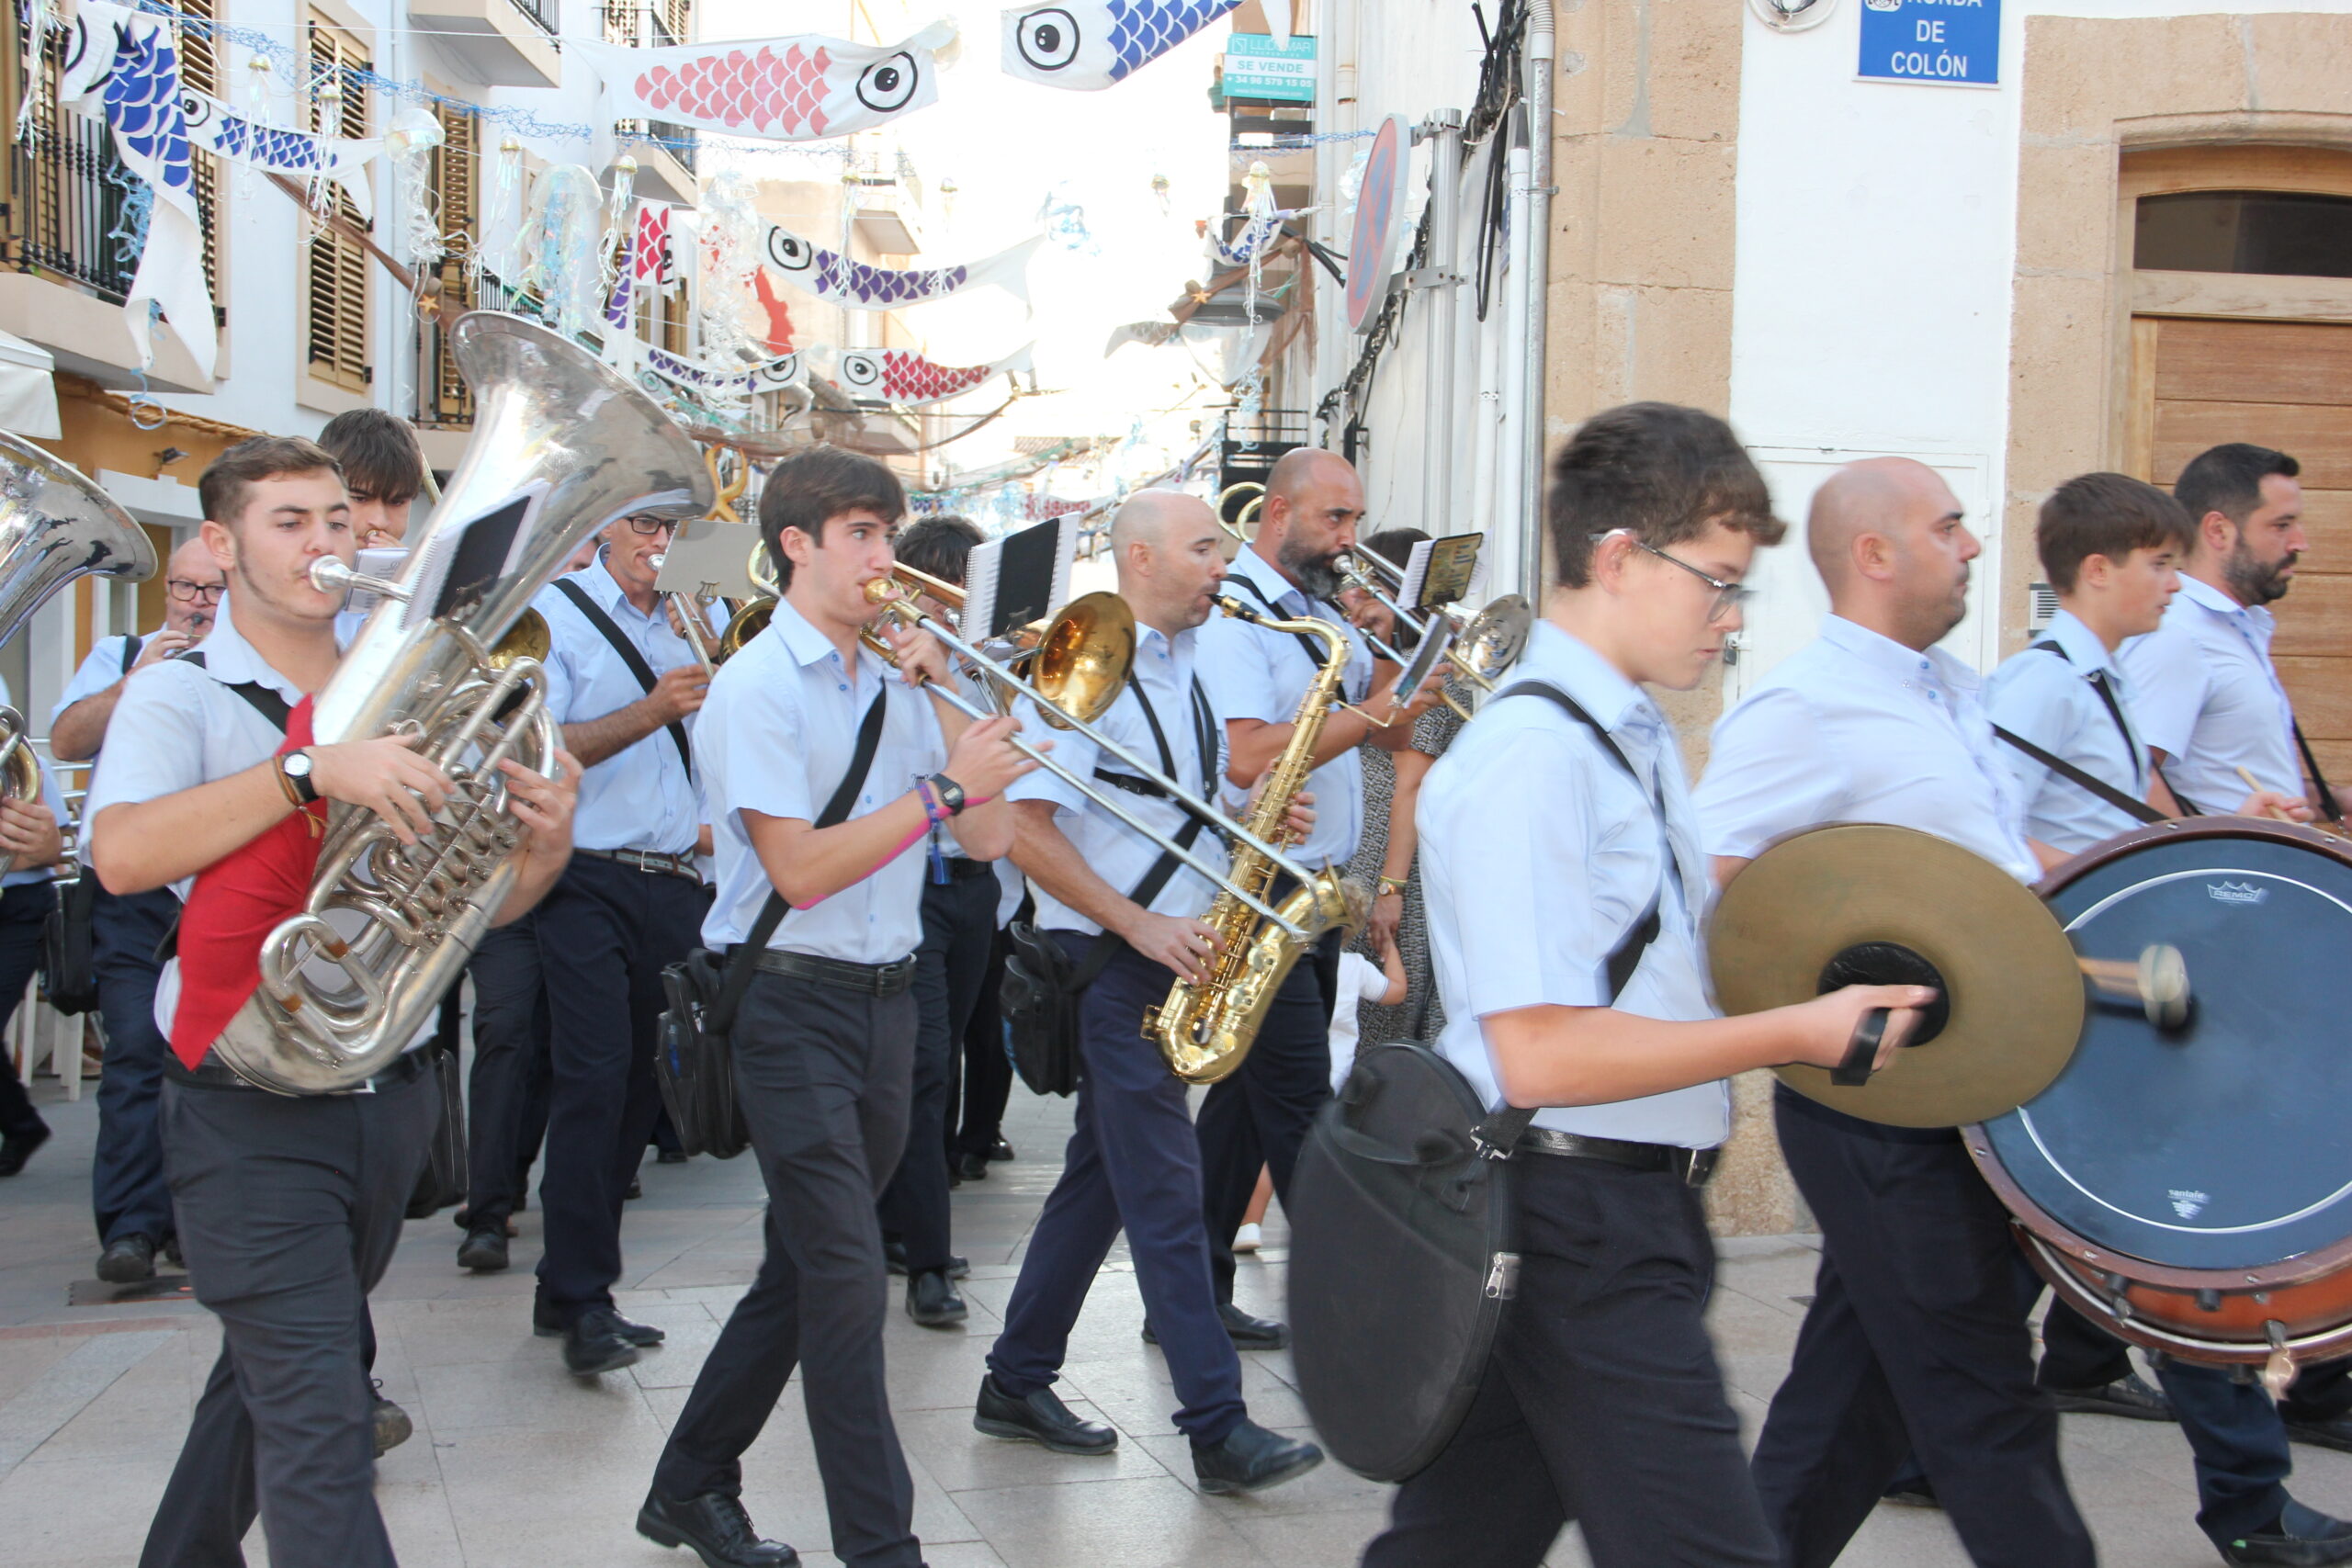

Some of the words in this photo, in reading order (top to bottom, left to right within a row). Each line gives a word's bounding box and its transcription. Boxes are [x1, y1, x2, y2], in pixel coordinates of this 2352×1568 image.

[1916, 19, 1946, 43] DE
[1250, 39, 1311, 52] LLIDMAR
[1238, 60, 1254, 71] SE
[1259, 62, 1304, 73] VENDE
[1891, 49, 1968, 77] COLÓN
[1235, 75, 1248, 84] 34
[1285, 78, 1297, 87] 15
[1300, 79, 1312, 87] 05
[2213, 890, 2254, 898] REMO
